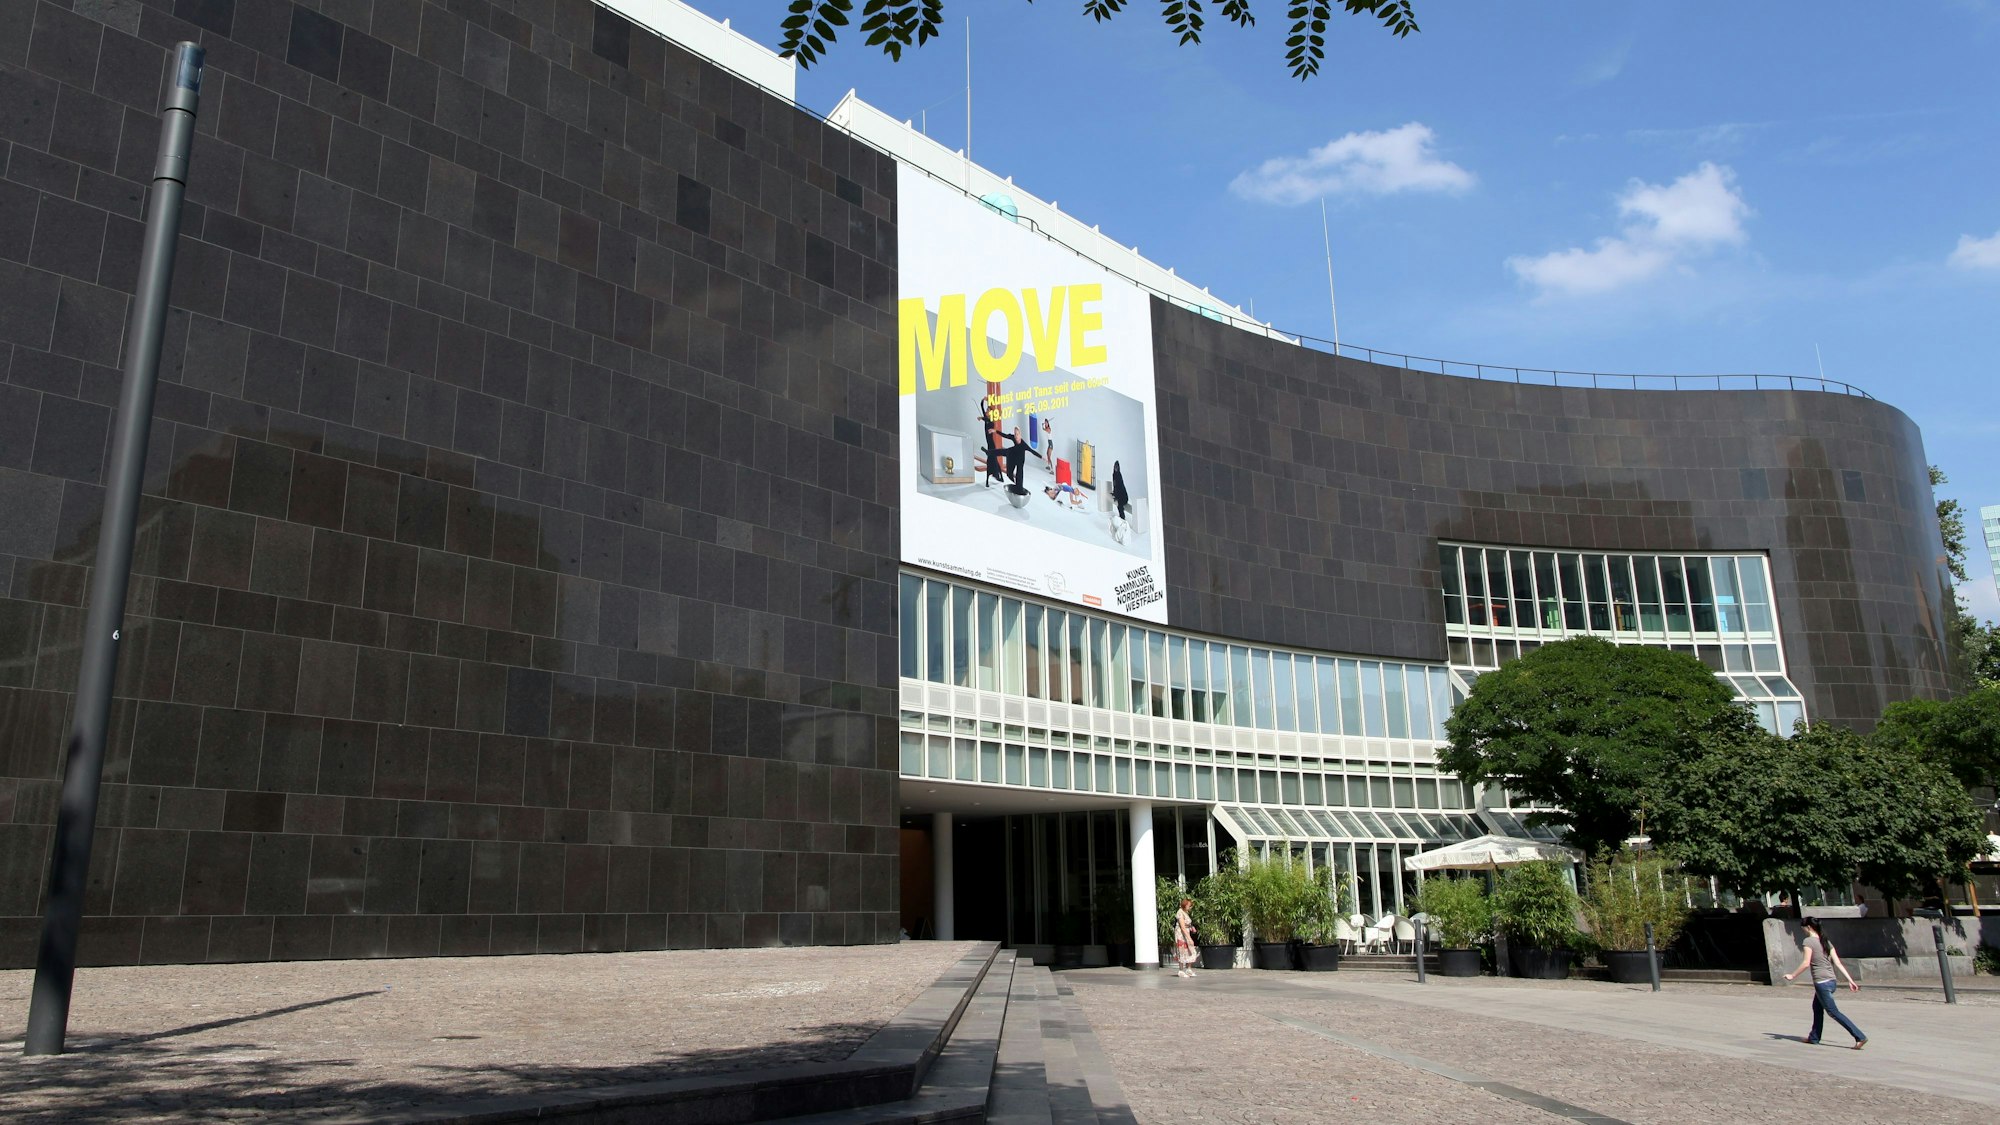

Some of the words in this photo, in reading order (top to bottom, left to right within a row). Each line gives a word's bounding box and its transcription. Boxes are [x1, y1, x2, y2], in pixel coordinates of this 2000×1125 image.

[899, 283, 1108, 396] MOVE
[987, 392, 1013, 406] Kunst
[1016, 388, 1032, 400] und
[1034, 385, 1053, 398] Tanz
[1054, 382, 1069, 395] seit
[1071, 380, 1086, 392] den
[988, 406, 1014, 422] 19.07.
[1024, 396, 1069, 415] 25.09.2011
[918, 557, 982, 578] www.kunstsammlung.de
[1125, 565, 1149, 581] KUNST
[1114, 574, 1154, 596] SAMMLUNG
[1117, 583, 1155, 606] NORDRHEIN
[1125, 589, 1164, 613] WESTFALEN
[112, 629, 120, 641] 6
